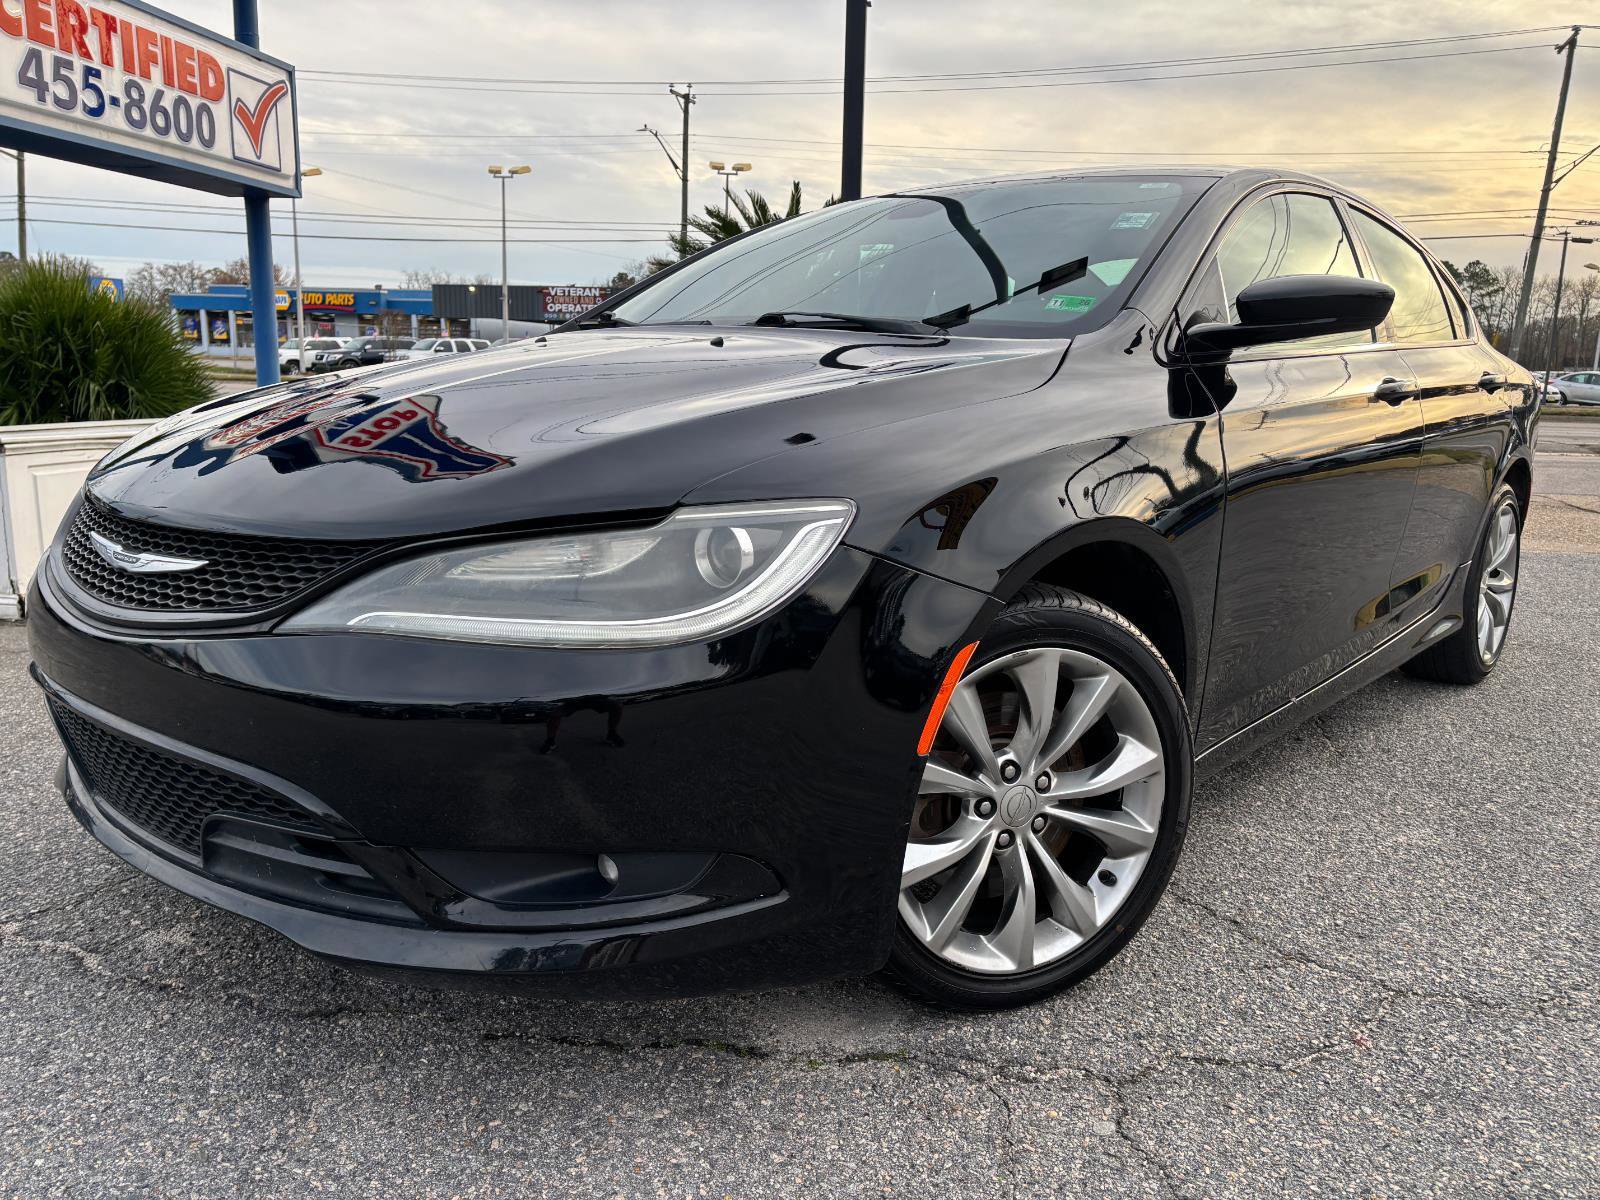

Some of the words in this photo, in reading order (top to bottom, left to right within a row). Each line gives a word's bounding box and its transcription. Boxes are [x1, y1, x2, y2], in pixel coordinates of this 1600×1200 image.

[0, 0, 225, 102] CERTIFIED
[18, 47, 216, 149] 455-8600
[549, 287, 600, 297] VETERAN
[325, 293, 355, 305] PARTS
[553, 296, 578, 304] OWNED
[580, 296, 595, 304] AND
[547, 304, 597, 312] OPERATE
